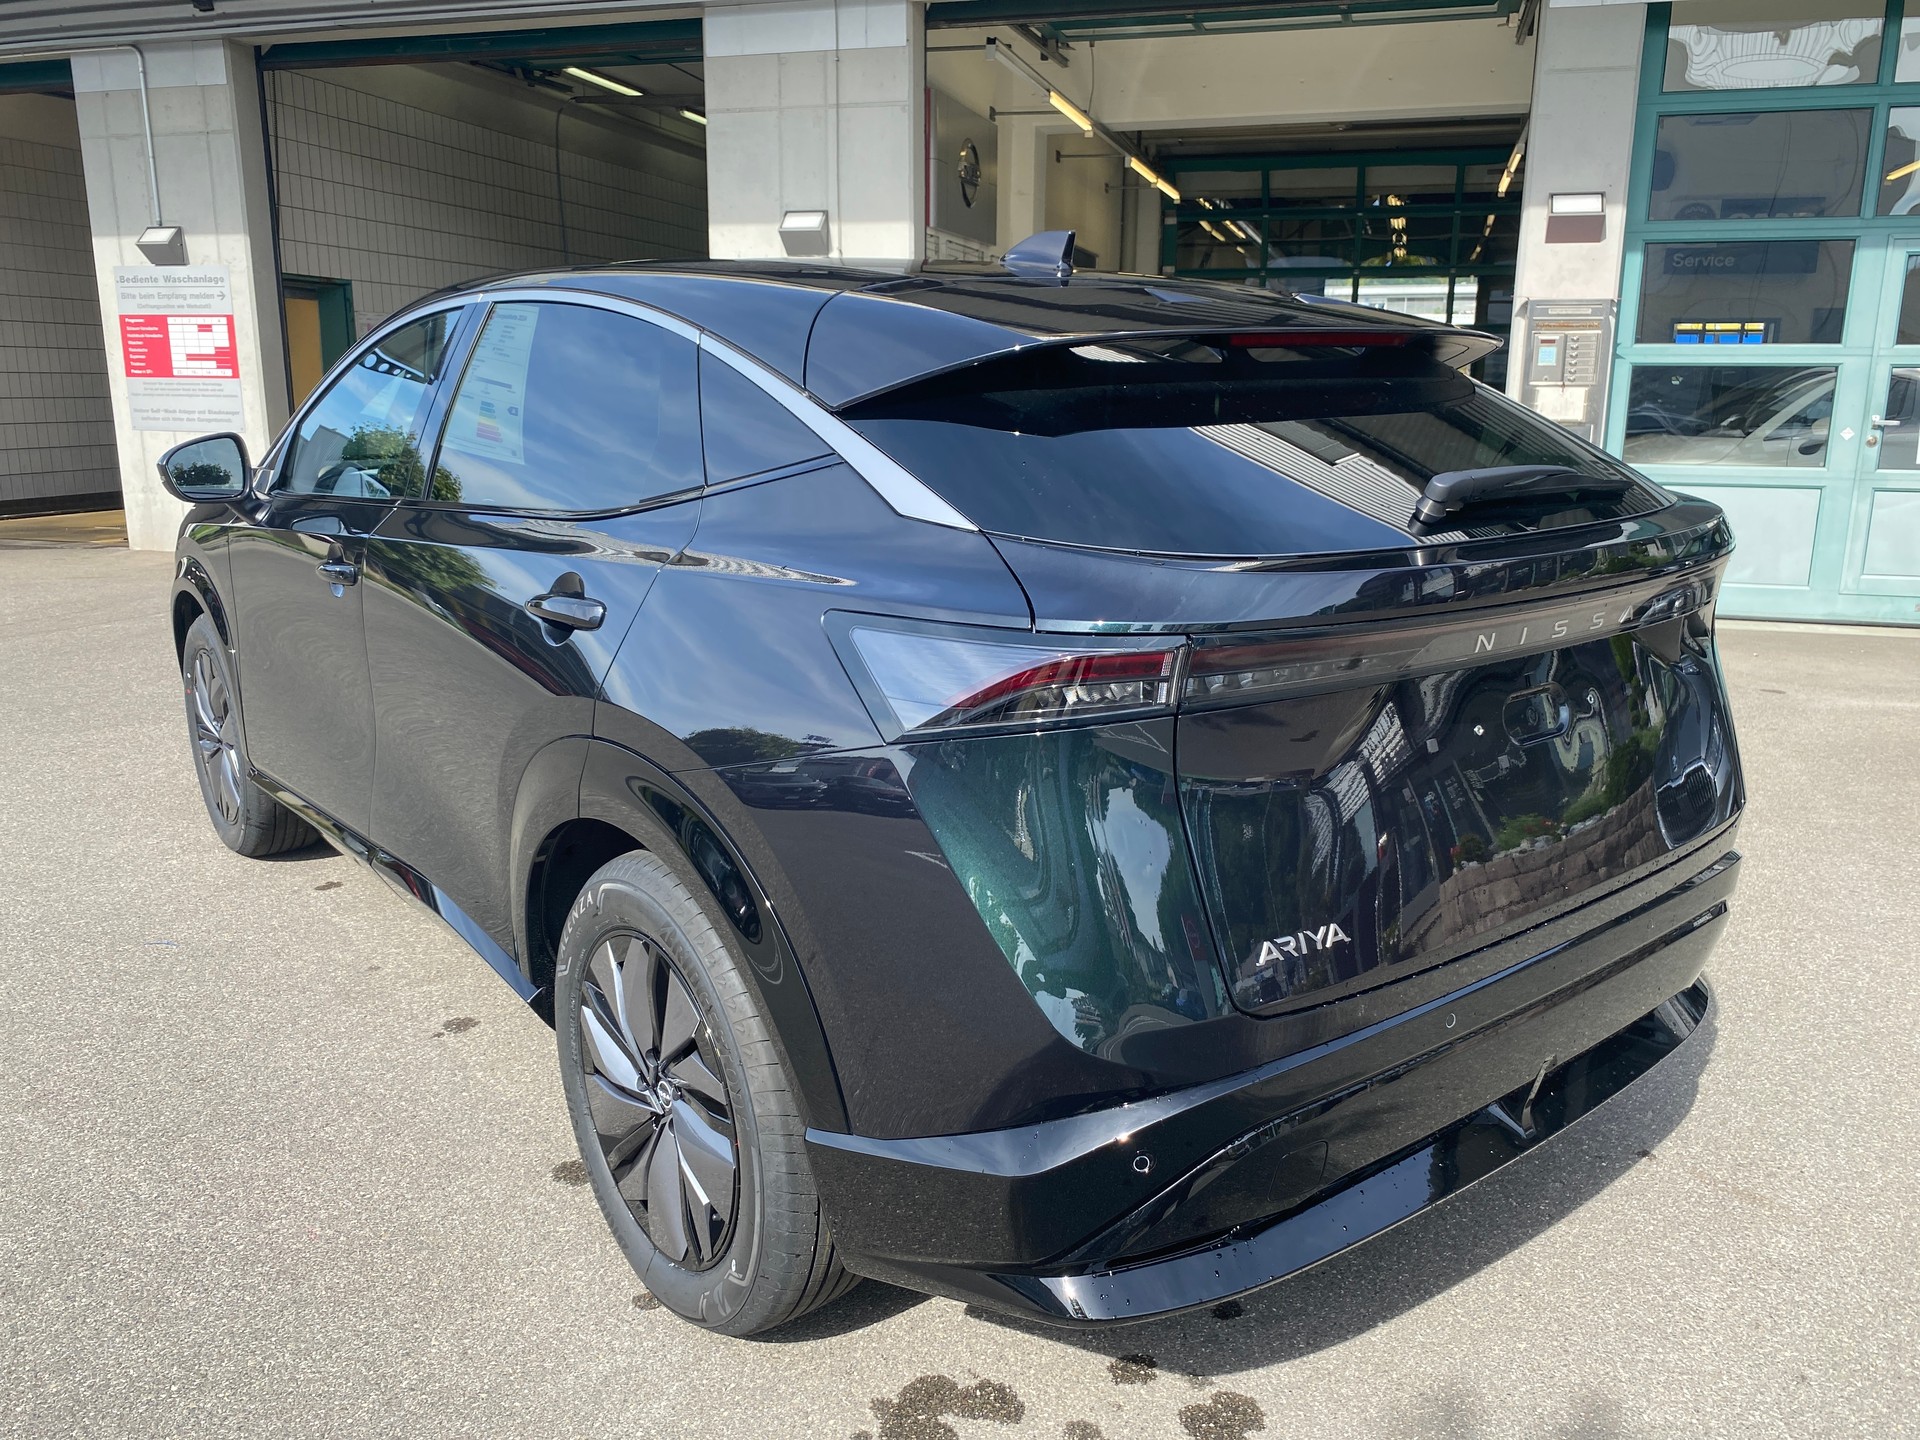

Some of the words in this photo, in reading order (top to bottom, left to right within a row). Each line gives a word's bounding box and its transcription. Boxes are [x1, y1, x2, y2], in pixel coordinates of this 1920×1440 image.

[1672, 253, 1735, 267] Service
[119, 275, 159, 284] Bediente
[163, 274, 225, 285] Waschanlage
[121, 292, 137, 300] Bitte
[139, 292, 155, 300] beim
[157, 291, 187, 302] Empfang
[189, 291, 215, 300] melden
[1474, 604, 1635, 653] NISSA
[558, 890, 595, 961] ALENZA
[1255, 923, 1352, 967] ARIYA
